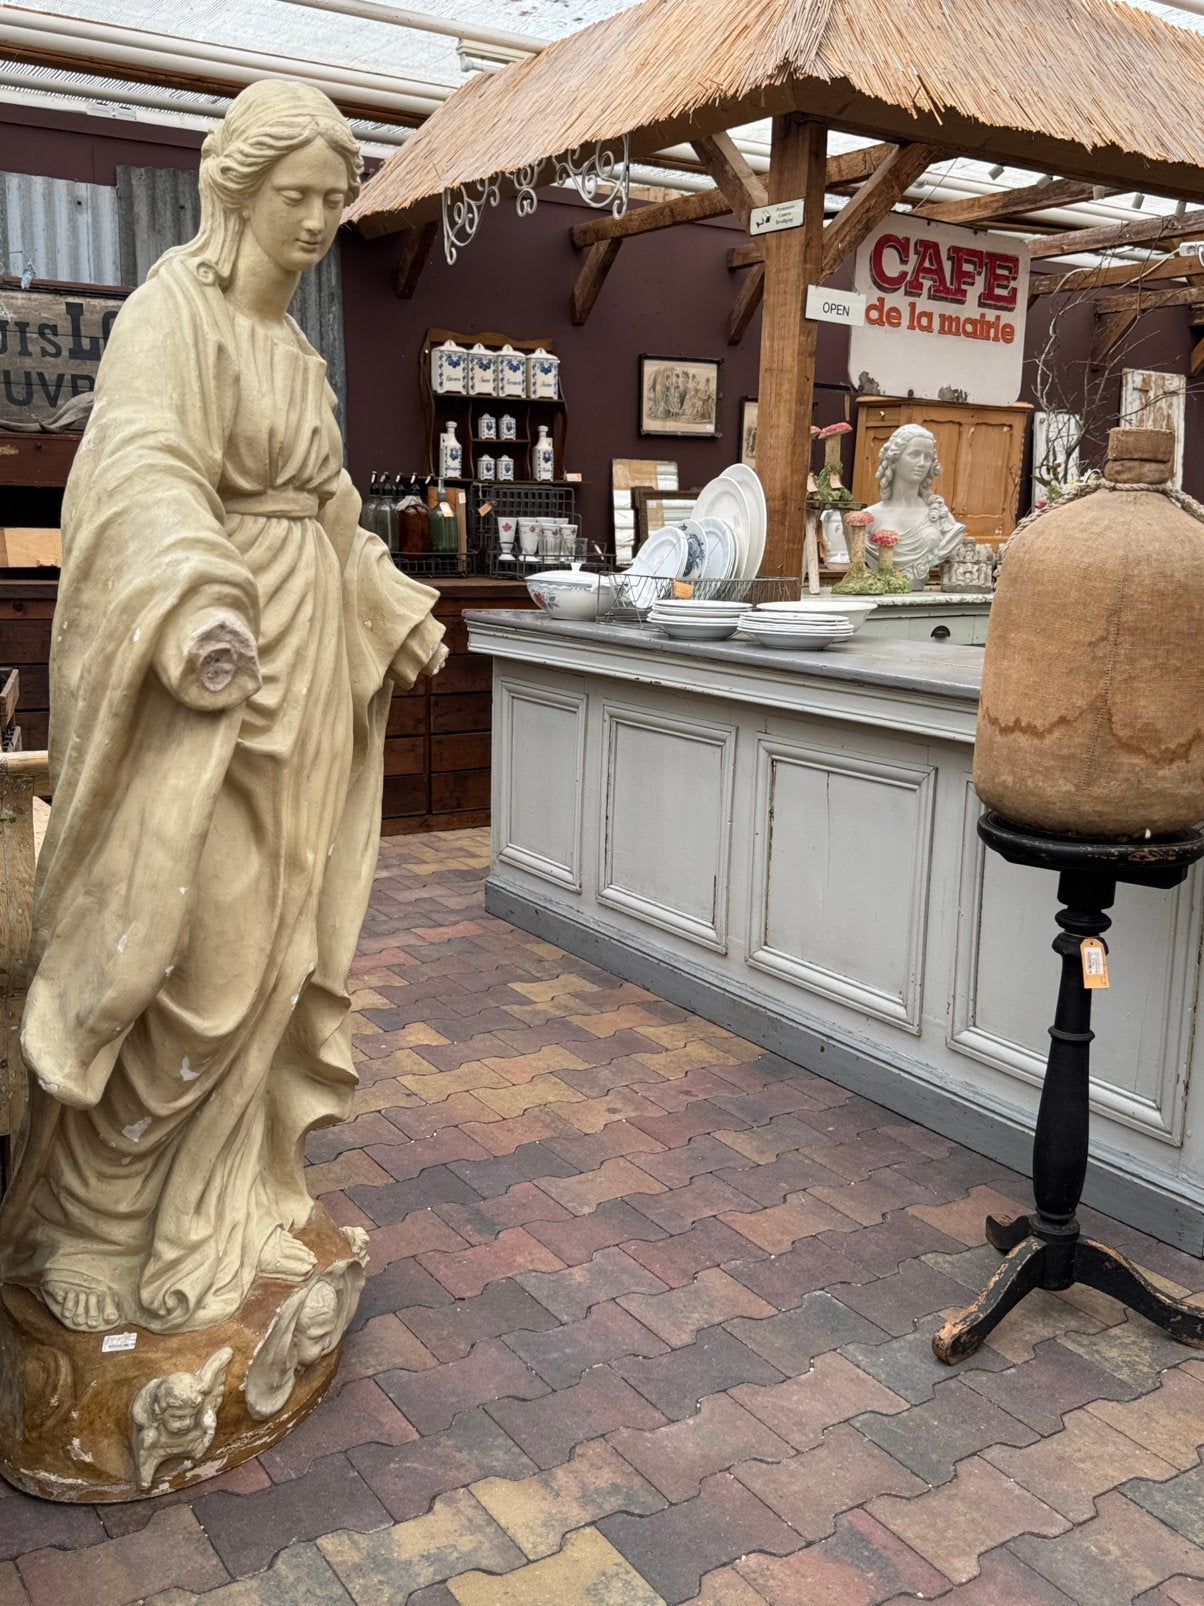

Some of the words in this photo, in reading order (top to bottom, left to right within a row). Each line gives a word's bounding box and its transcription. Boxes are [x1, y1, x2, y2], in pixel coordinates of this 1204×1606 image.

[869, 234, 1020, 312] CAFE
[822, 302, 850, 316] OPEN
[865, 297, 902, 327] de
[907, 302, 934, 333] la
[938, 312, 1015, 344] mairie
